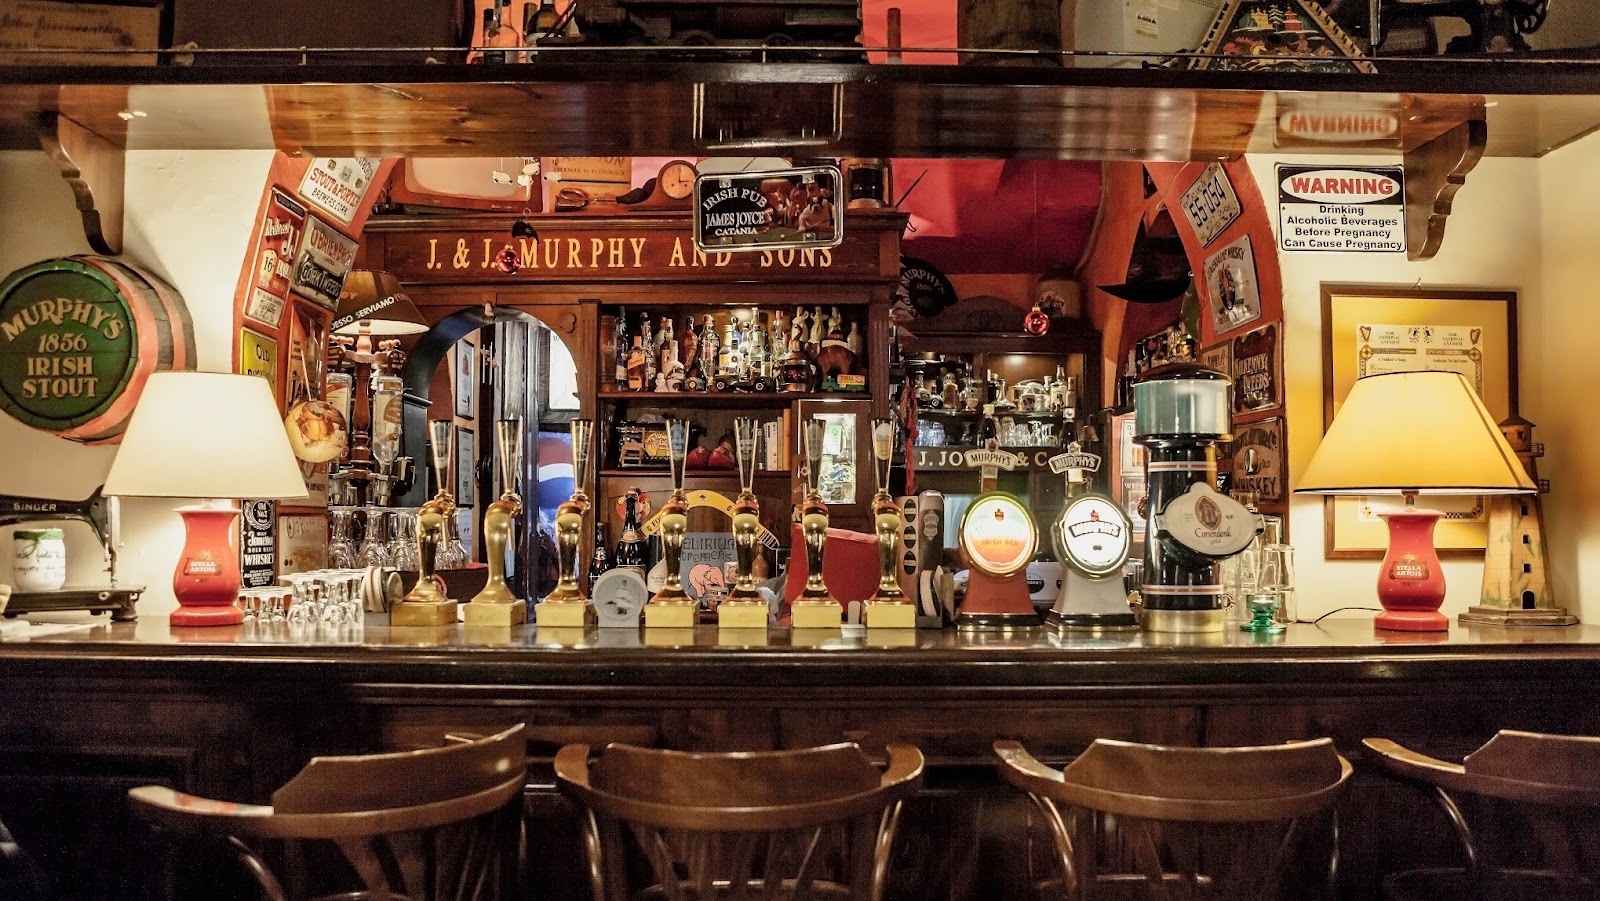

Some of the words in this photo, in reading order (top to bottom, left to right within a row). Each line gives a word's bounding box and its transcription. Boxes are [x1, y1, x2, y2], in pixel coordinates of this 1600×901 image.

[1290, 177, 1393, 195] WARNING
[702, 188, 738, 211] IRISH
[741, 187, 768, 208] PUB
[1320, 206, 1364, 216] Drinking
[706, 212, 735, 230] JAMES
[736, 211, 765, 228] JOYCE
[1287, 216, 1337, 225] Alcoholic
[1341, 217, 1398, 227] Beverages
[714, 227, 758, 236] CATANIA
[1295, 228, 1330, 236] Before
[1334, 228, 1391, 238] Pregnancy
[1284, 239, 1305, 248] Can
[1309, 239, 1342, 248] Cause
[1346, 240, 1402, 250] Pregnancy
[426, 239, 442, 269] J.
[453, 238, 470, 269] &
[481, 238, 497, 269] J.
[519, 238, 646, 268] MURPHY
[670, 237, 732, 268] AND
[760, 247, 832, 268] SONS
[1, 298, 125, 342] MURPHY'S
[331, 314, 354, 330] DESSO
[355, 296, 395, 318] SERVIAMO
[38, 333, 87, 354] 1856
[27, 356, 94, 376] IRISH
[22, 378, 98, 399] STOUT
[918, 452, 934, 466] J.
[1014, 452, 1030, 466] &
[970, 454, 1012, 467] MURPHY'S
[1054, 454, 1096, 468] MURPHY'S
[14, 502, 57, 512] SINGER
[1194, 526, 1232, 538] Corsendonk
[682, 537, 736, 550] ELIRIU
